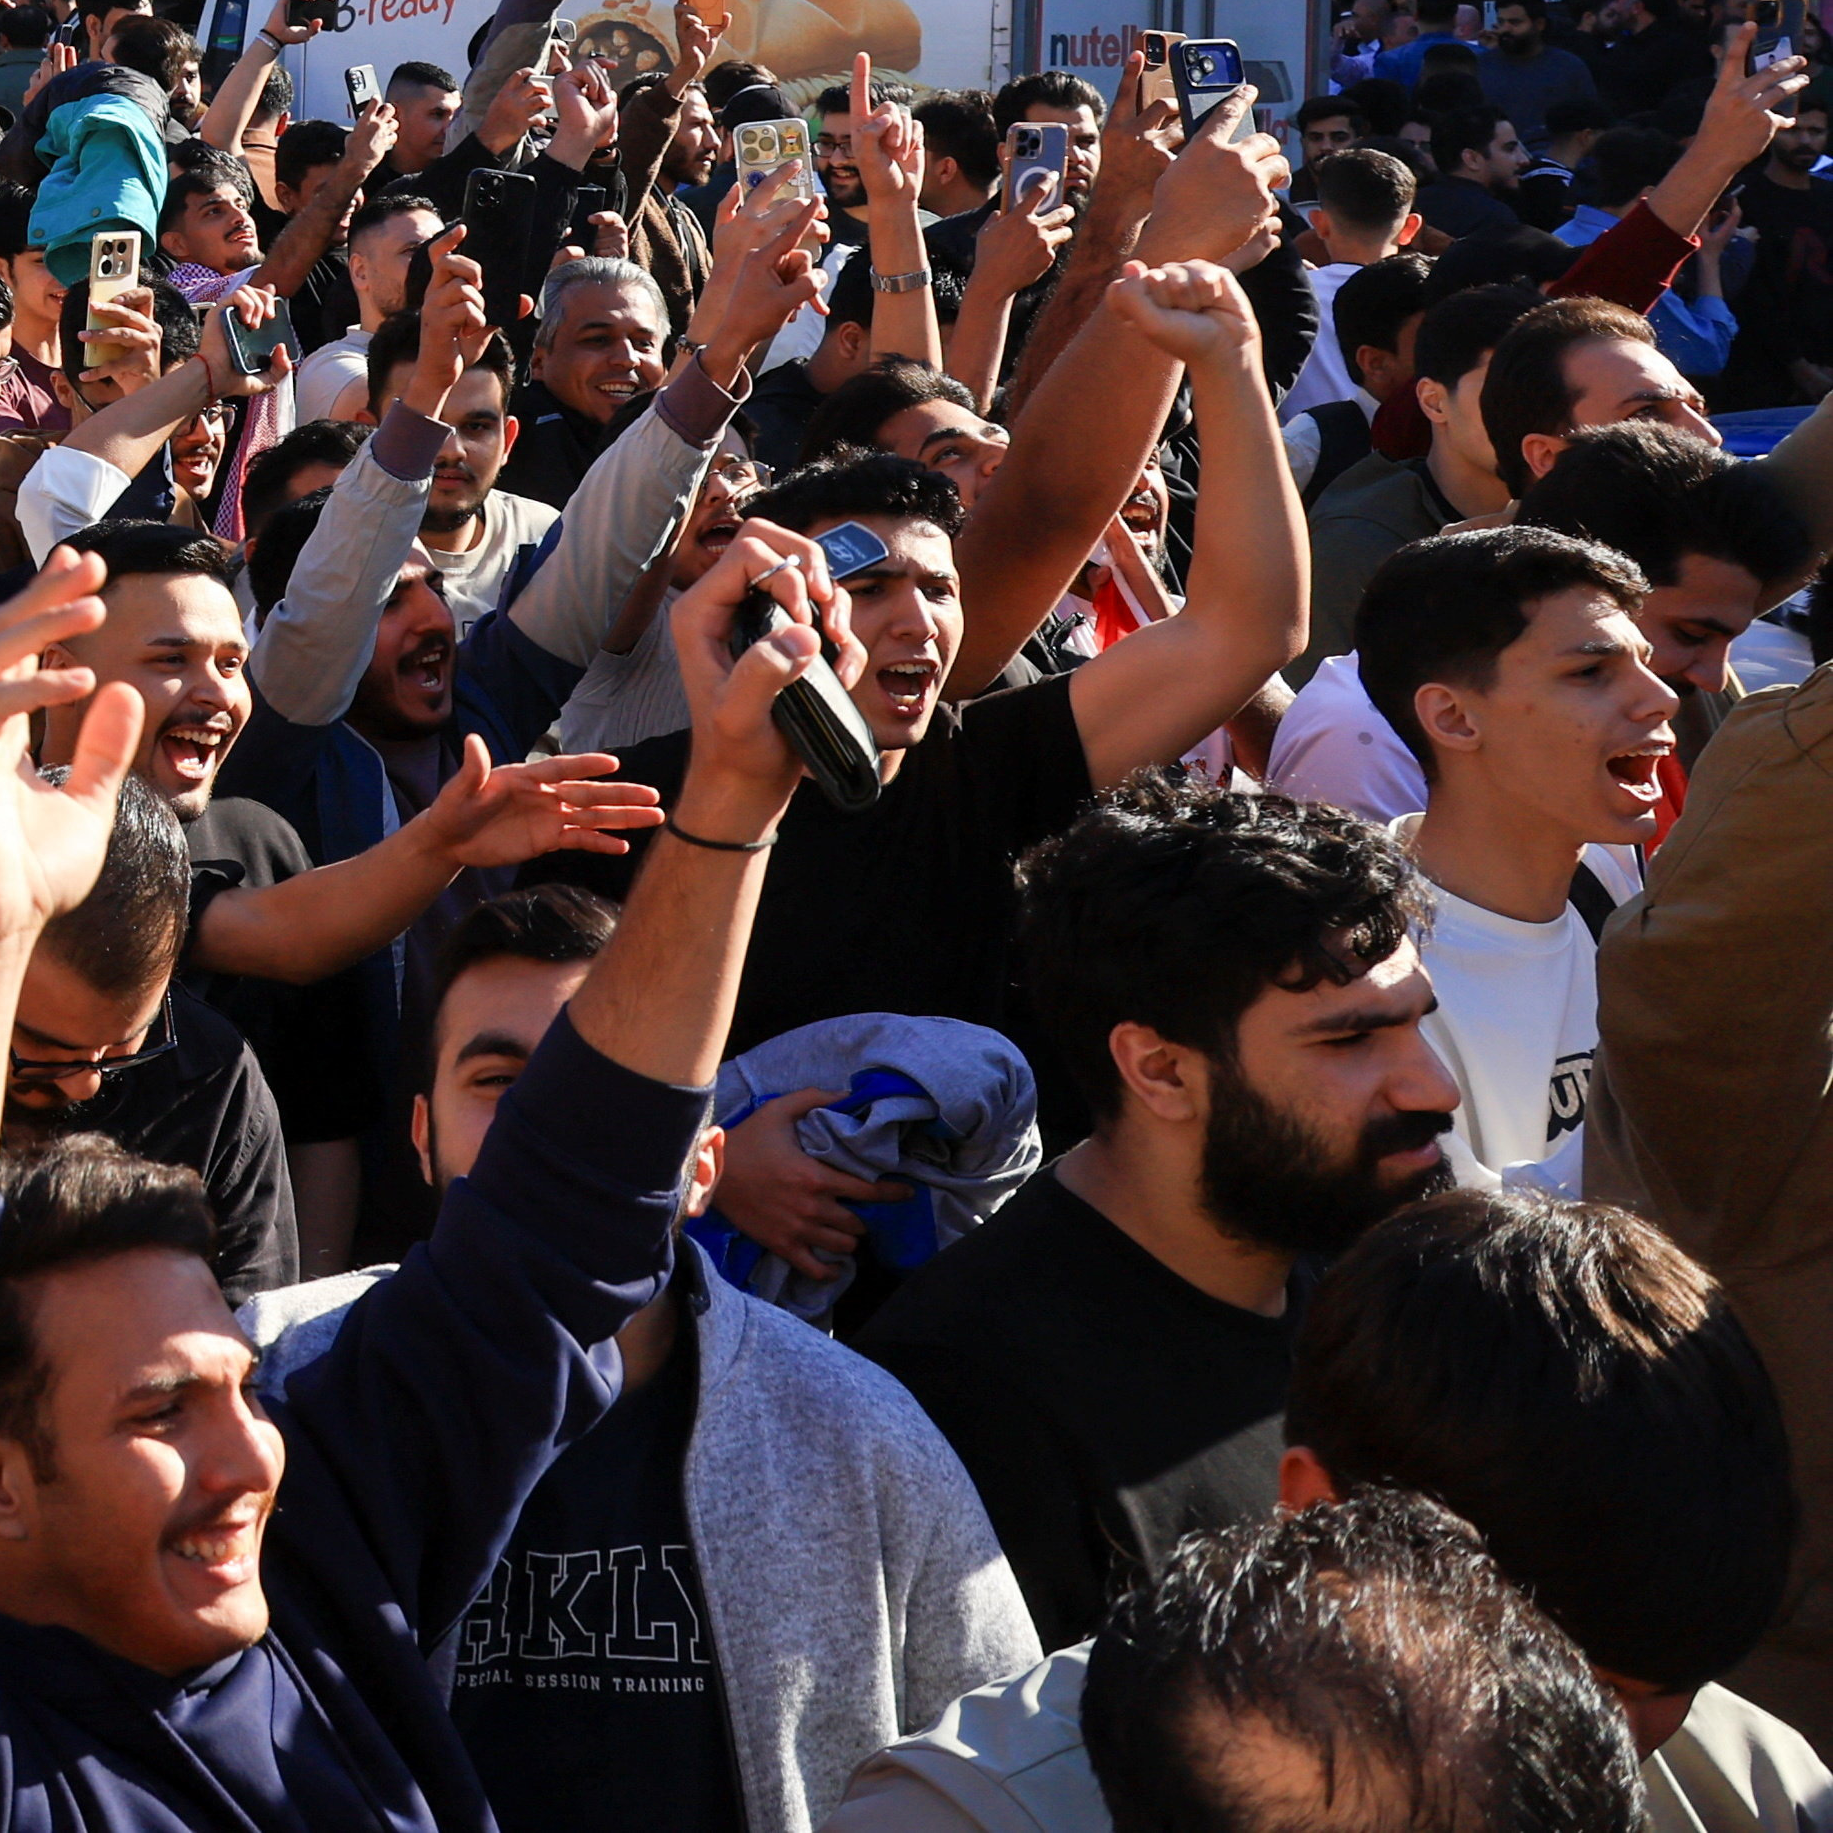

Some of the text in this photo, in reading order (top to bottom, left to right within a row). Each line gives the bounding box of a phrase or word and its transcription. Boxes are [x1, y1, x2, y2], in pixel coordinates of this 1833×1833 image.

[1050, 24, 1144, 68] nutell
[457, 1669, 705, 1693] PECIAL SESSION TRAINING
